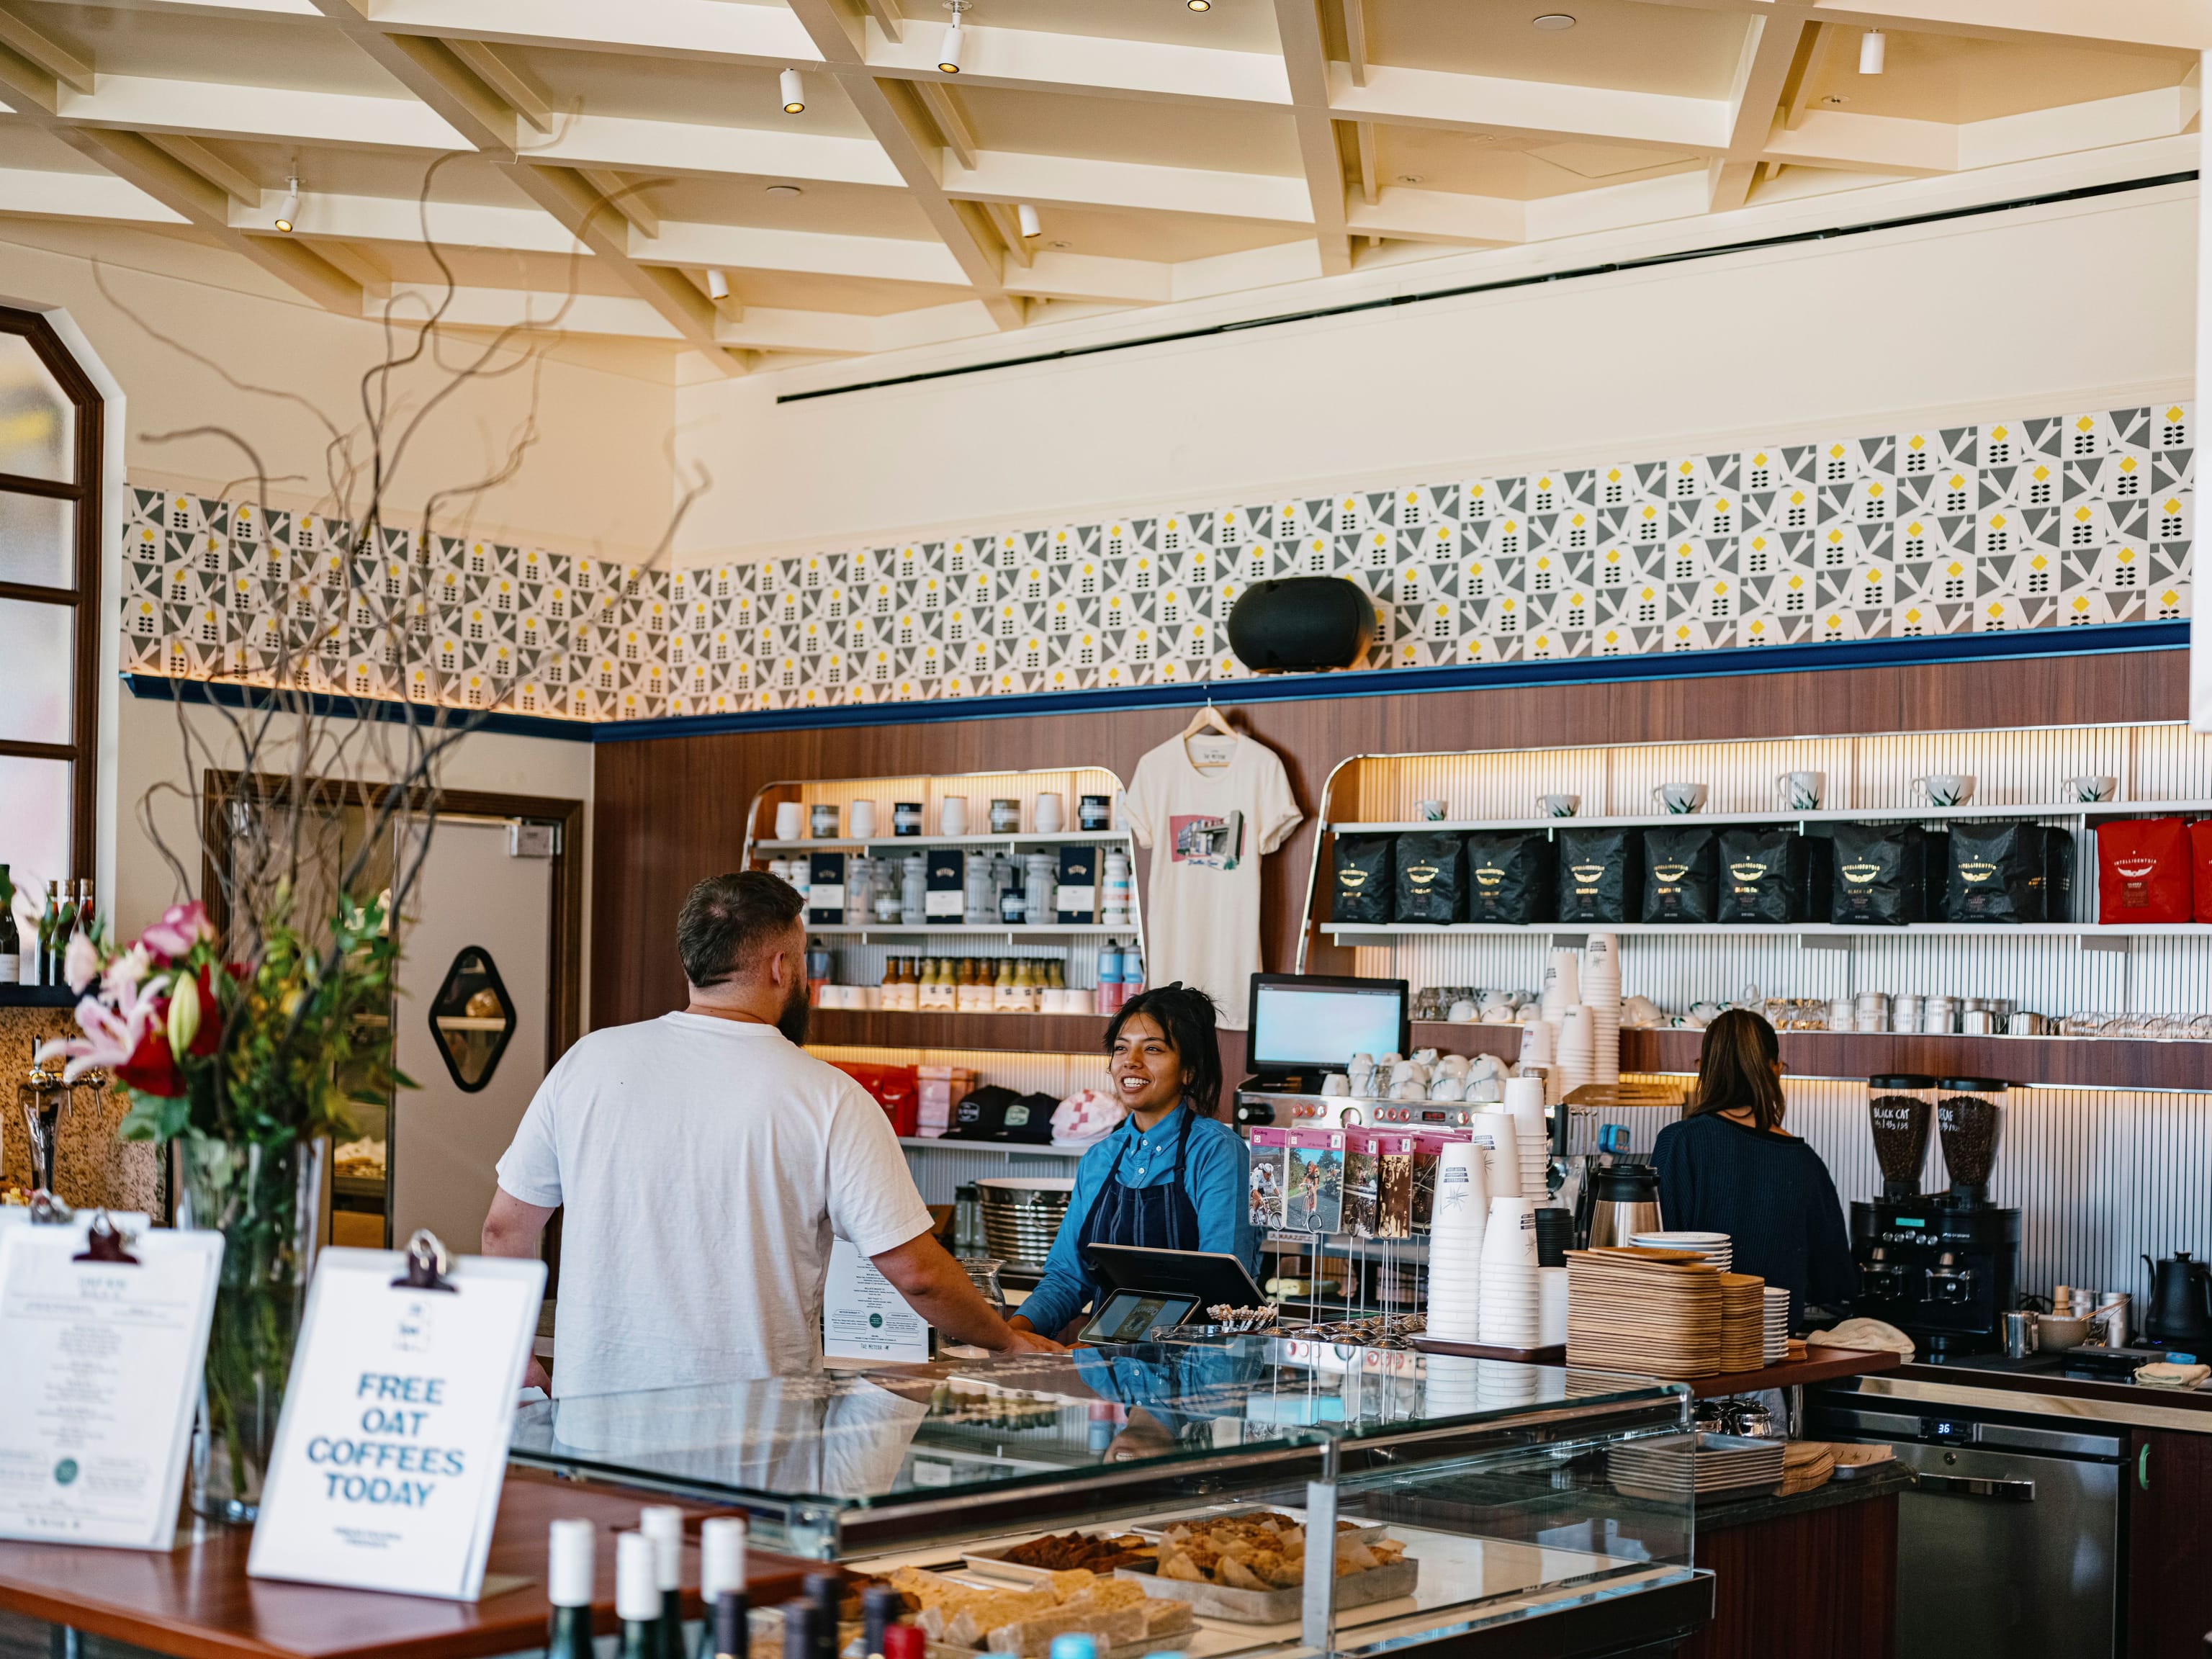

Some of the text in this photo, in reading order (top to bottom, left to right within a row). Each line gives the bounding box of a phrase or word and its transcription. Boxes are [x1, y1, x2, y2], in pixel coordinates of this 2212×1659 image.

[1874, 1107, 1910, 1119] BLACK CAT
[357, 1372, 445, 1406] FREE
[361, 1407, 428, 1439] OAT
[1938, 1424, 1950, 1433] 36
[307, 1437, 465, 1477] COFFEES
[324, 1472, 435, 1509] TODAY
